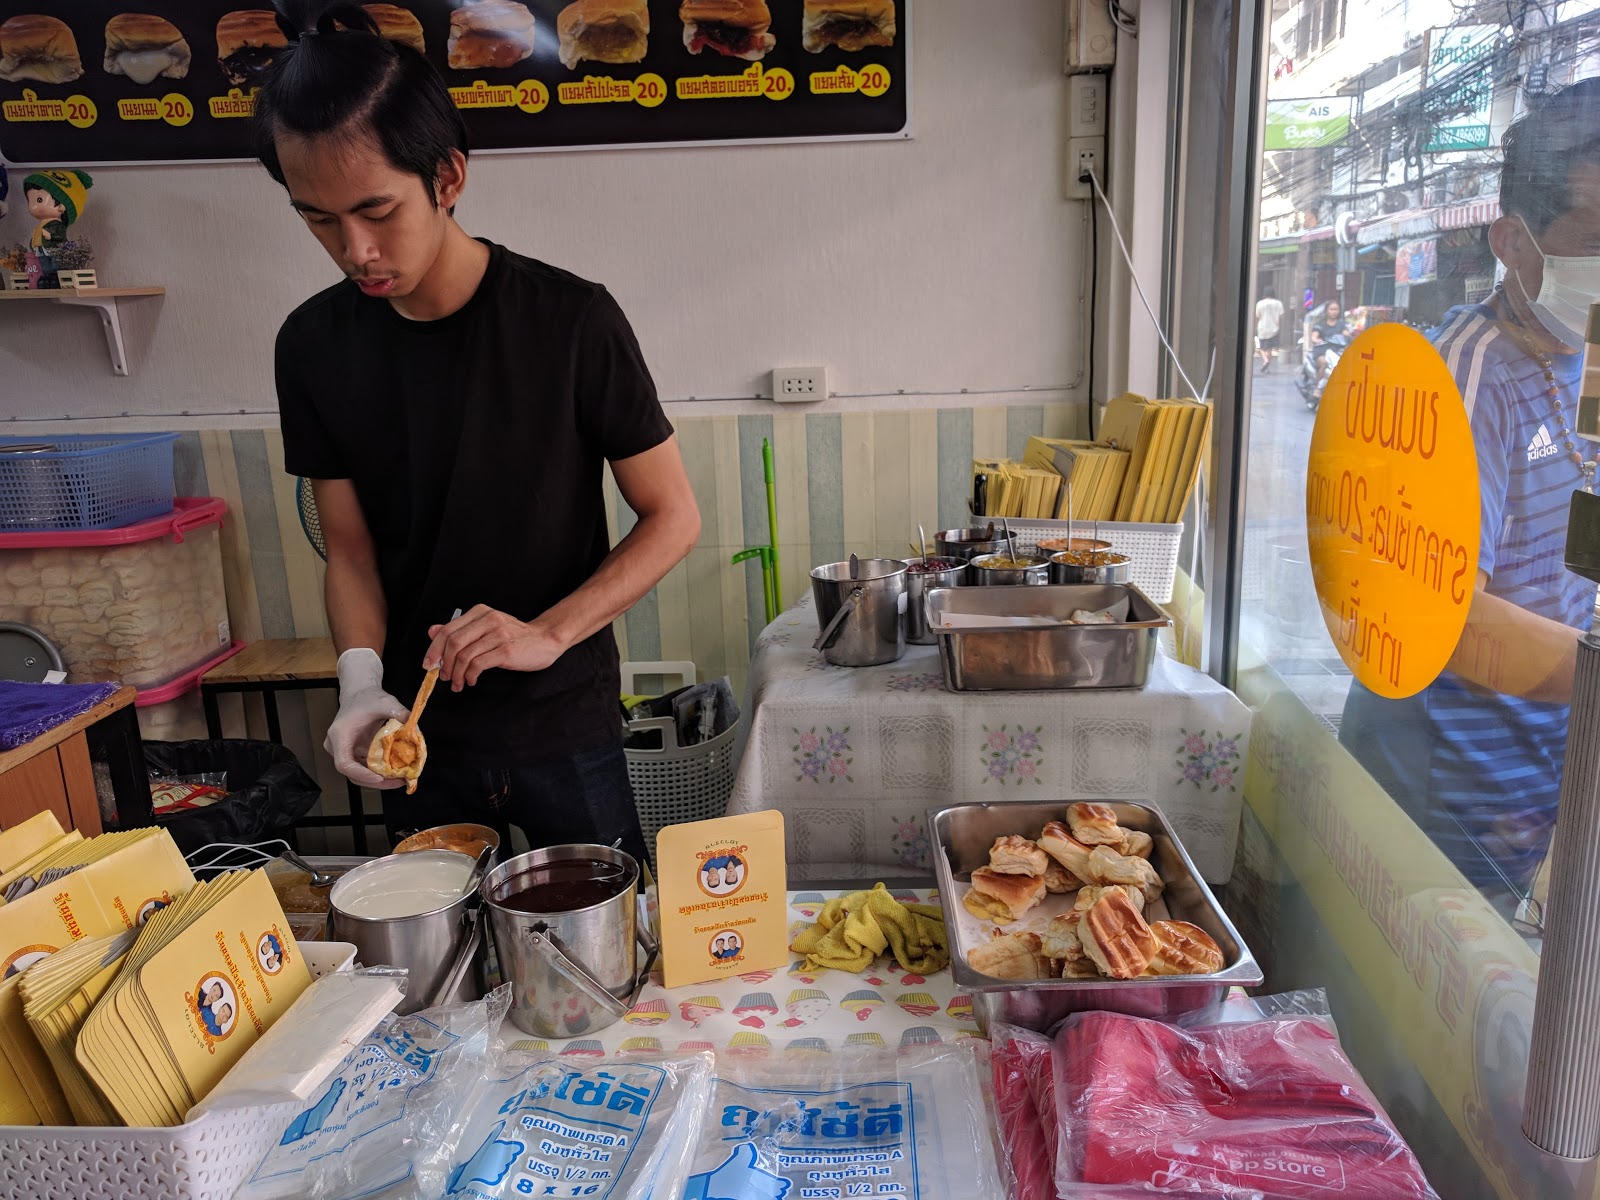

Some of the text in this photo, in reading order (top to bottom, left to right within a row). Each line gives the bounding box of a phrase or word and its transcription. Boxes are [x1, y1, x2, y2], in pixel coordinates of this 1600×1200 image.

[813, 69, 855, 90] แยมส้ม
[6, 92, 63, 118] เนยน้ำตาล
[451, 84, 513, 105] นยพริกเผา
[121, 103, 158, 116] เนยนม
[1309, 106, 1330, 117] AIS
[522, 1115, 627, 1147] คุณภาพเกรด A
[527, 1158, 560, 1179] บรรจุ
[565, 1168, 584, 1179] 1/2
[778, 1152, 888, 1167] คุณภาพเกรด
[891, 1150, 903, 1159] A
[1213, 1151, 1326, 1177] App Store
[516, 1178, 534, 1194] 8
[571, 1185, 600, 1196] 16
[802, 1187, 839, 1199] บรรจุ
[847, 1184, 871, 1196] 1/2
